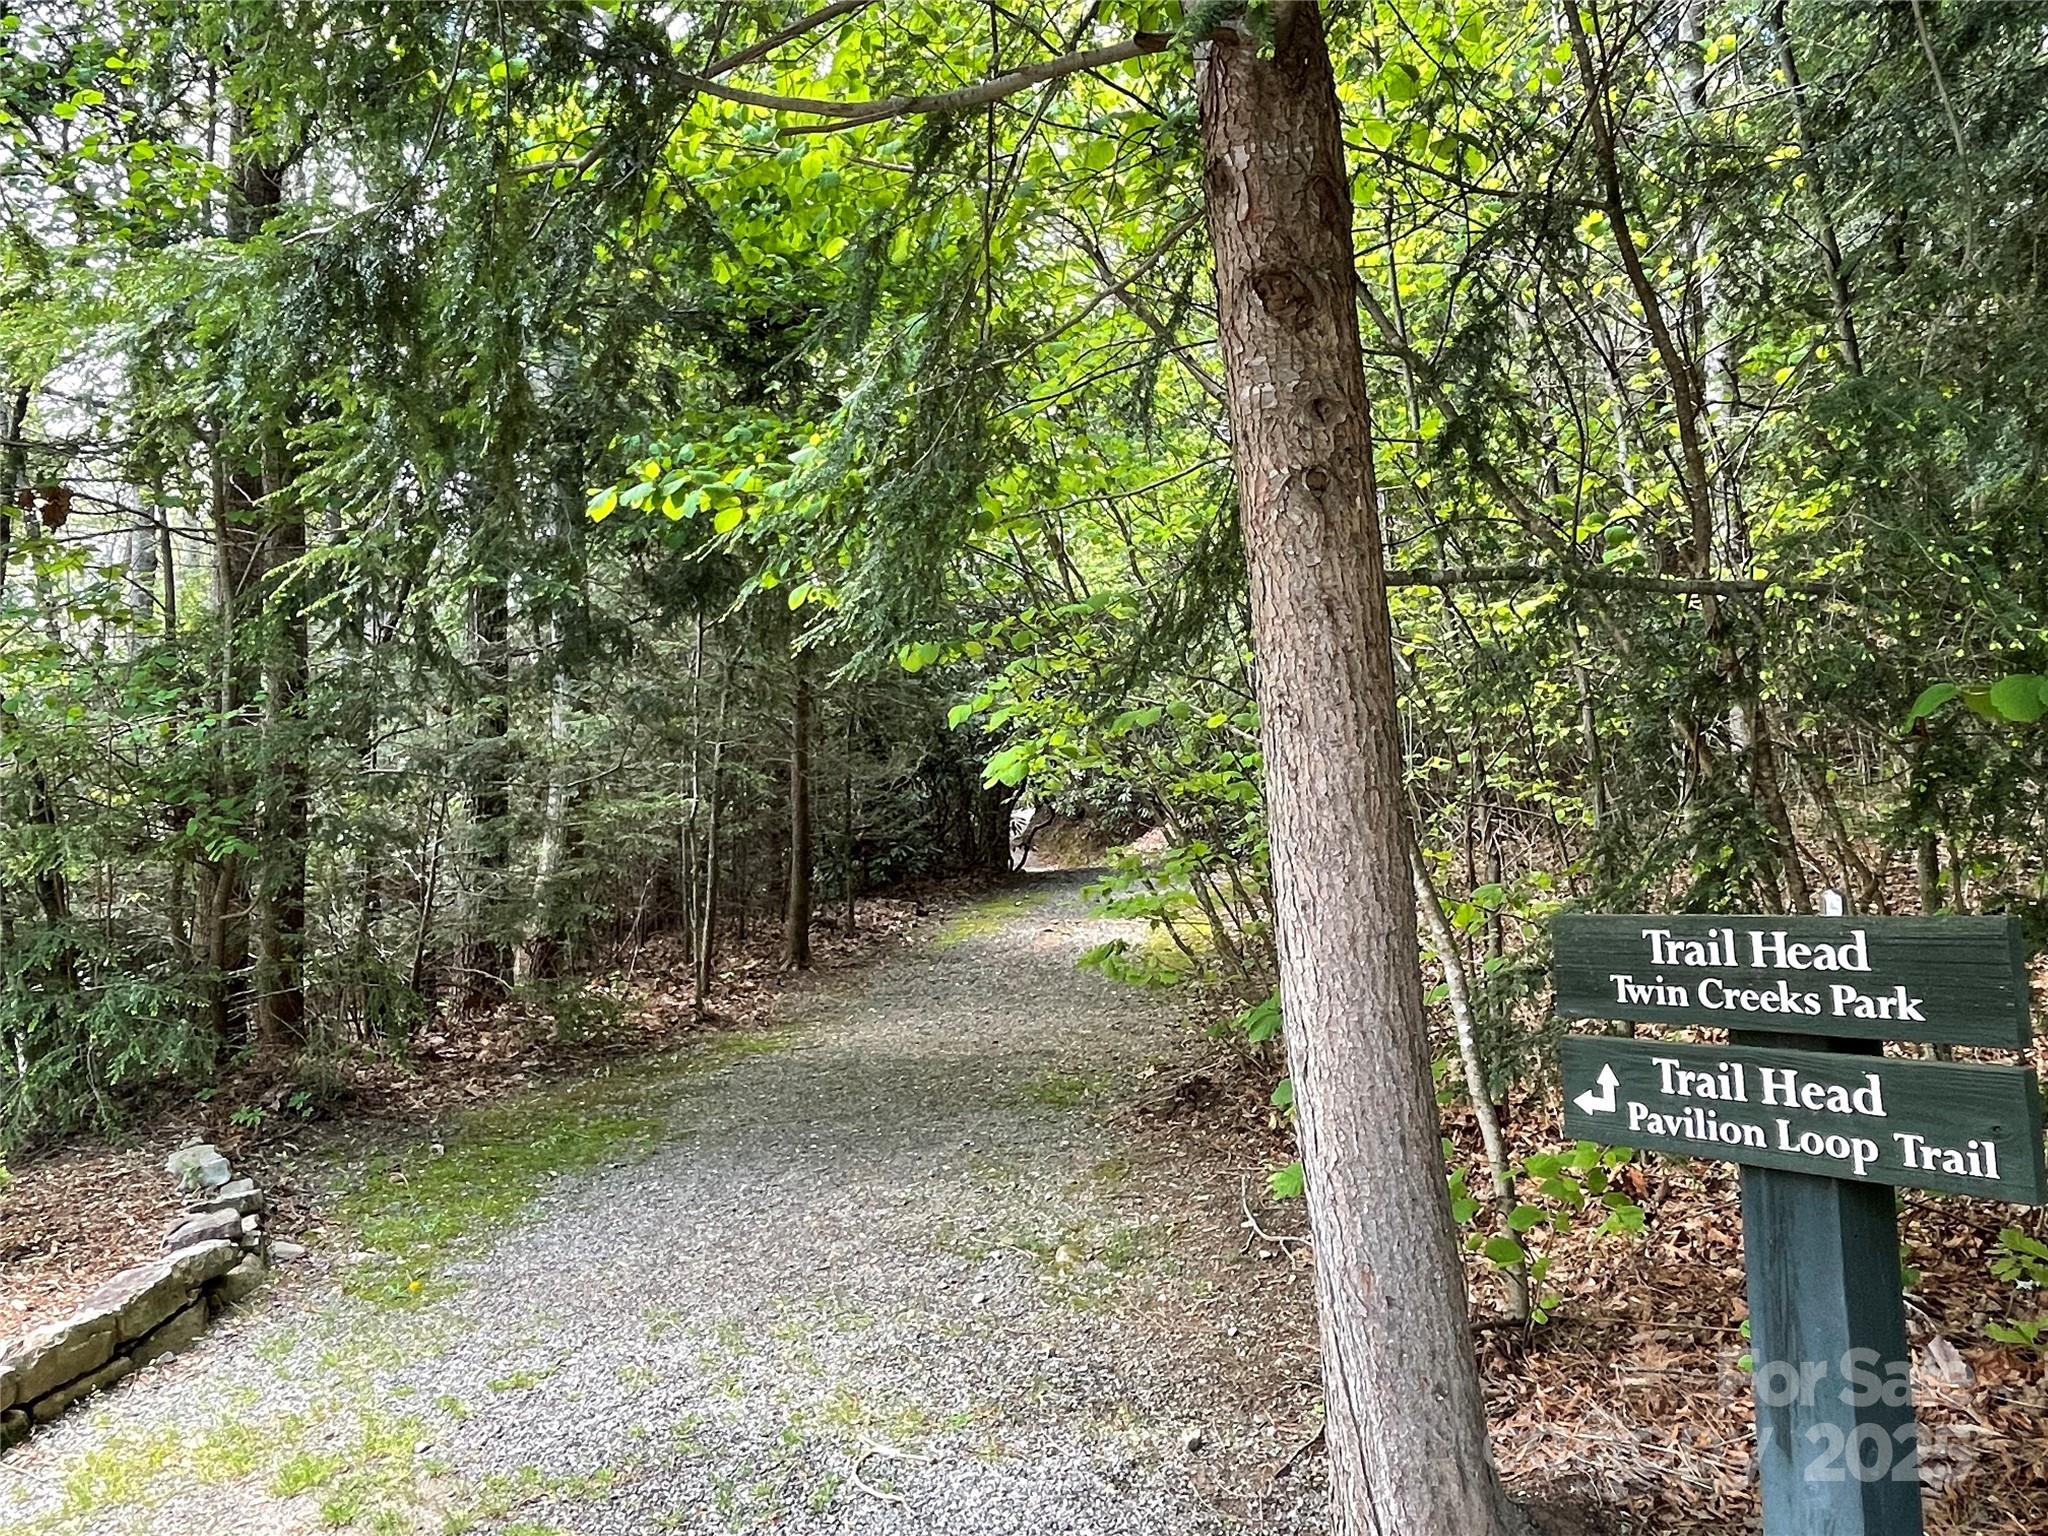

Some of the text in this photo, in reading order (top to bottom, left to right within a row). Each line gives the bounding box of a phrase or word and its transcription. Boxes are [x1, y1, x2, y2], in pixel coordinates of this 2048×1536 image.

[1642, 928, 1872, 972] Trail Head
[1610, 975, 1927, 1022] Twin Creeks Park
[1652, 1057, 1888, 1117] Trail Head
[1627, 1102, 2001, 1180] Pavilion Loop Trail
